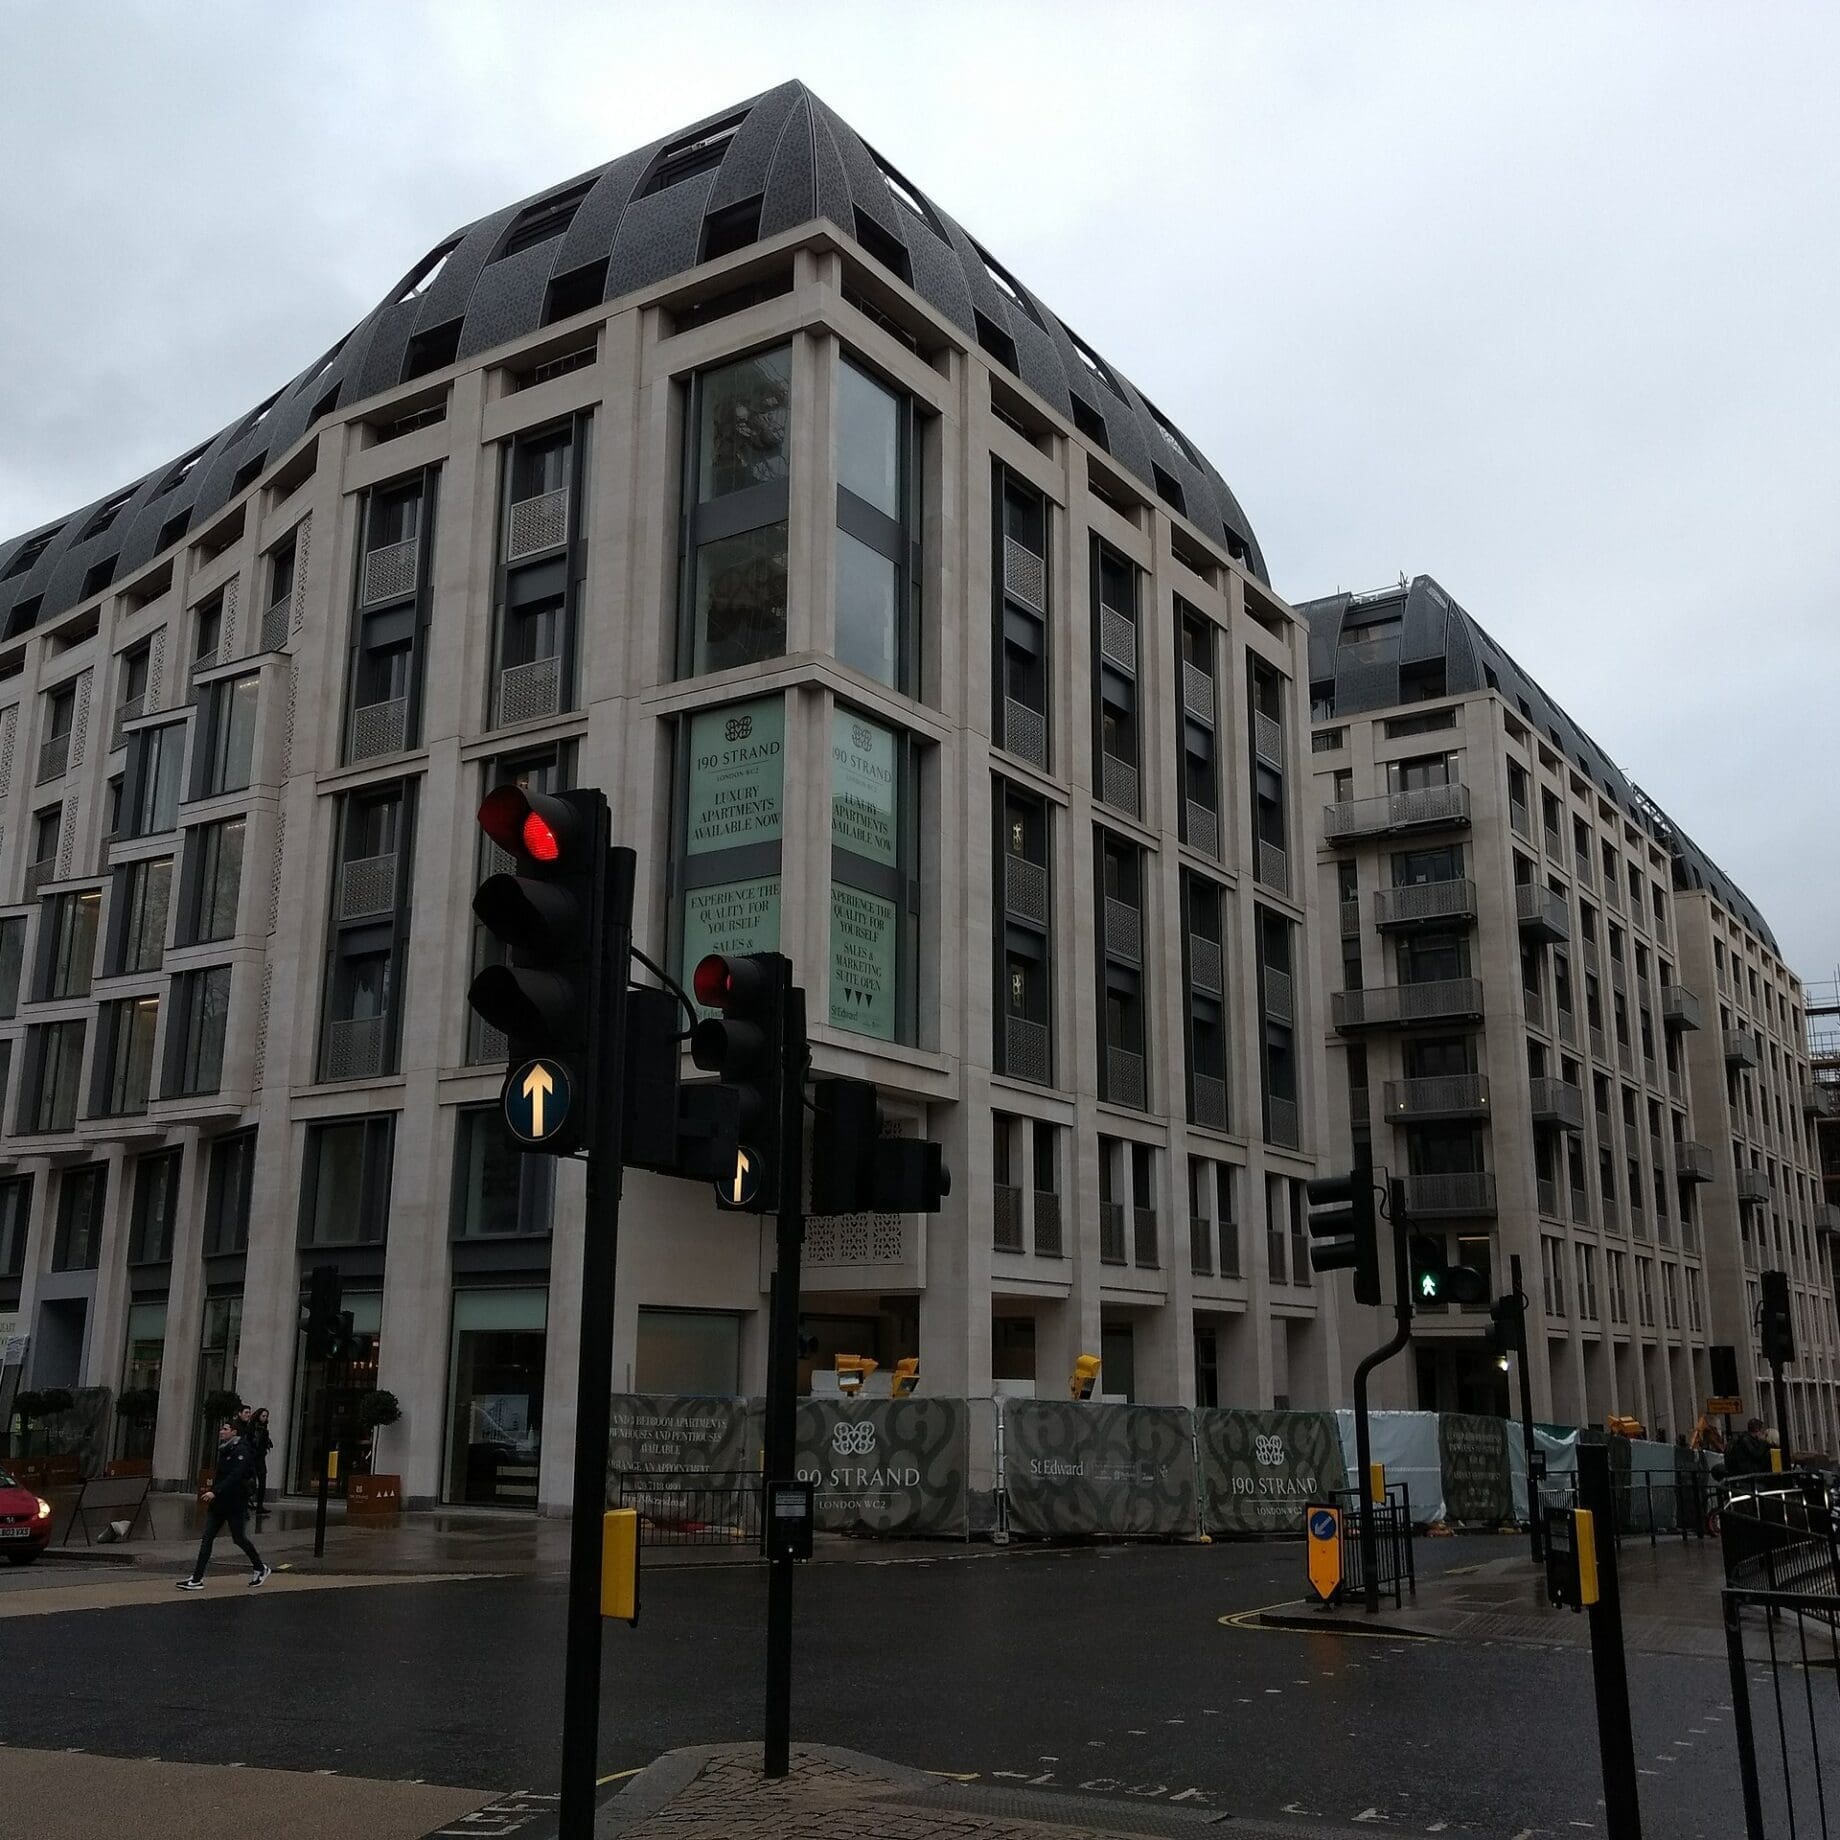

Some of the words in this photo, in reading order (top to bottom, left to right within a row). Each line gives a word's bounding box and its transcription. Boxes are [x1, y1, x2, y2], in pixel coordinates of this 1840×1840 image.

[697, 755, 718, 771] 190
[722, 741, 781, 766] STRAND
[850, 754, 892, 783] STRAND
[714, 785, 760, 806] LUXURY
[844, 791, 878, 816] LUXURY
[699, 798, 776, 824] APARTMENTS
[832, 803, 889, 835] APARTMENTS
[692, 818, 753, 841] AVAILABLE
[755, 813, 782, 829] NOW
[831, 816, 873, 845] VAILABLE
[689, 887, 755, 910] EXPERIENCE
[757, 883, 780, 897] THE
[831, 888, 875, 913] XPERIENCE
[875, 902, 893, 920] THE
[699, 905, 746, 923] QUALITY
[748, 900, 770, 914] FOR
[833, 904, 868, 926] QUALITY
[869, 916, 885, 931] FOR
[707, 915, 761, 934] YOURSELF
[839, 920, 879, 943] YOURSELF
[712, 939, 745, 953] SALES
[746, 938, 754, 949] &
[843, 943, 868, 958] SALES
[868, 949, 875, 961] &
[835, 953, 882, 978] MARKETING
[835, 968, 859, 986] SUITE
[860, 976, 882, 992] OPEN
[675, 1417, 728, 1429] APARTMENTS
[655, 1430, 672, 1441] AND
[672, 1431, 723, 1443] PENTHOUSES
[640, 1442, 681, 1455] AVAILABLE
[797, 1468, 822, 1488] 90
[829, 1467, 921, 1488] STRAND
[1030, 1458, 1043, 1475] St
[1043, 1459, 1084, 1477] Edward
[1232, 1476, 1255, 1495] 190
[1258, 1477, 1318, 1495] STRAND
[819, 1501, 862, 1510] LONDON
[863, 1500, 887, 1510] WC2
[1256, 1506, 1287, 1516] LONDON
